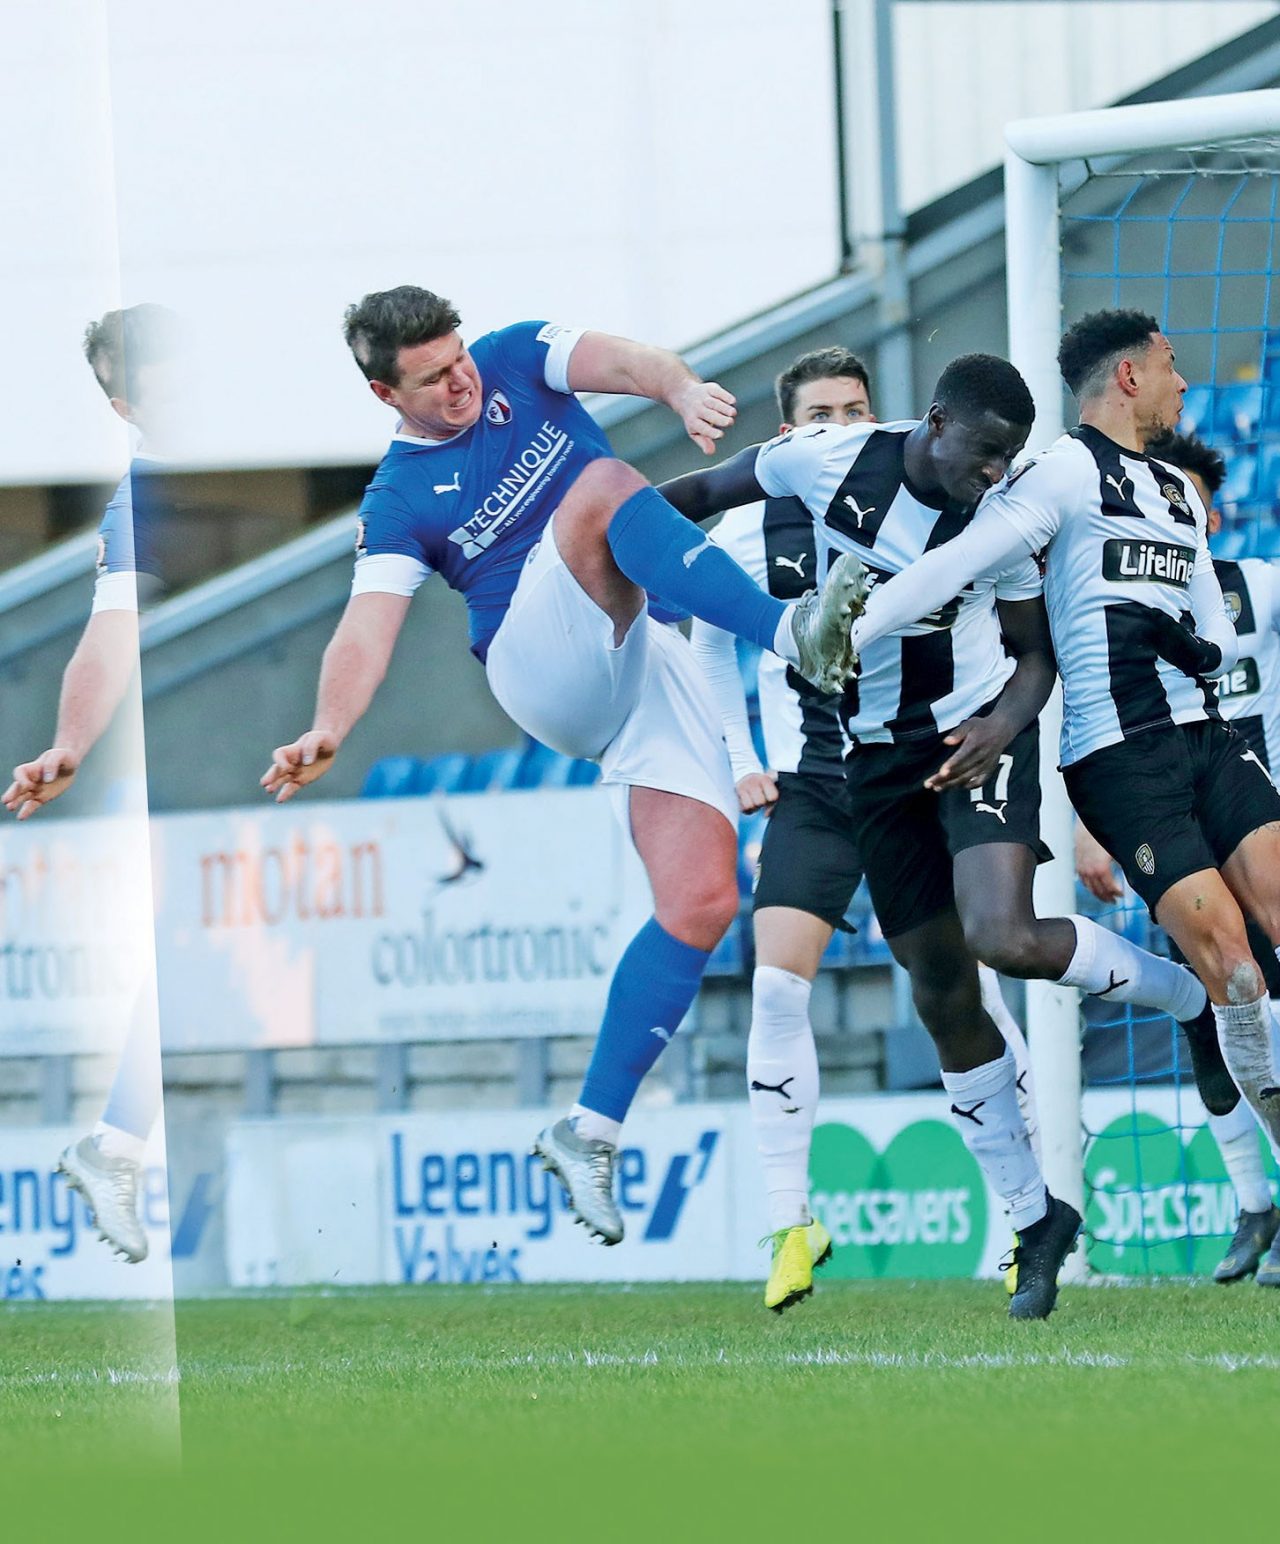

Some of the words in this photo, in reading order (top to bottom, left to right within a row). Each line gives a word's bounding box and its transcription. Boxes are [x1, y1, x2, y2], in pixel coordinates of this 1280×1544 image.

[463, 420, 562, 534] TECHNIQUE
[1120, 544, 1194, 584] Lifeline
[201, 835, 384, 927] motan
[372, 900, 609, 986] colortronic
[391, 1132, 648, 1240] Leenge
[809, 1183, 971, 1246] pecsavers
[1094, 1167, 1278, 1258] Specsav
[394, 1223, 524, 1283] Valves
